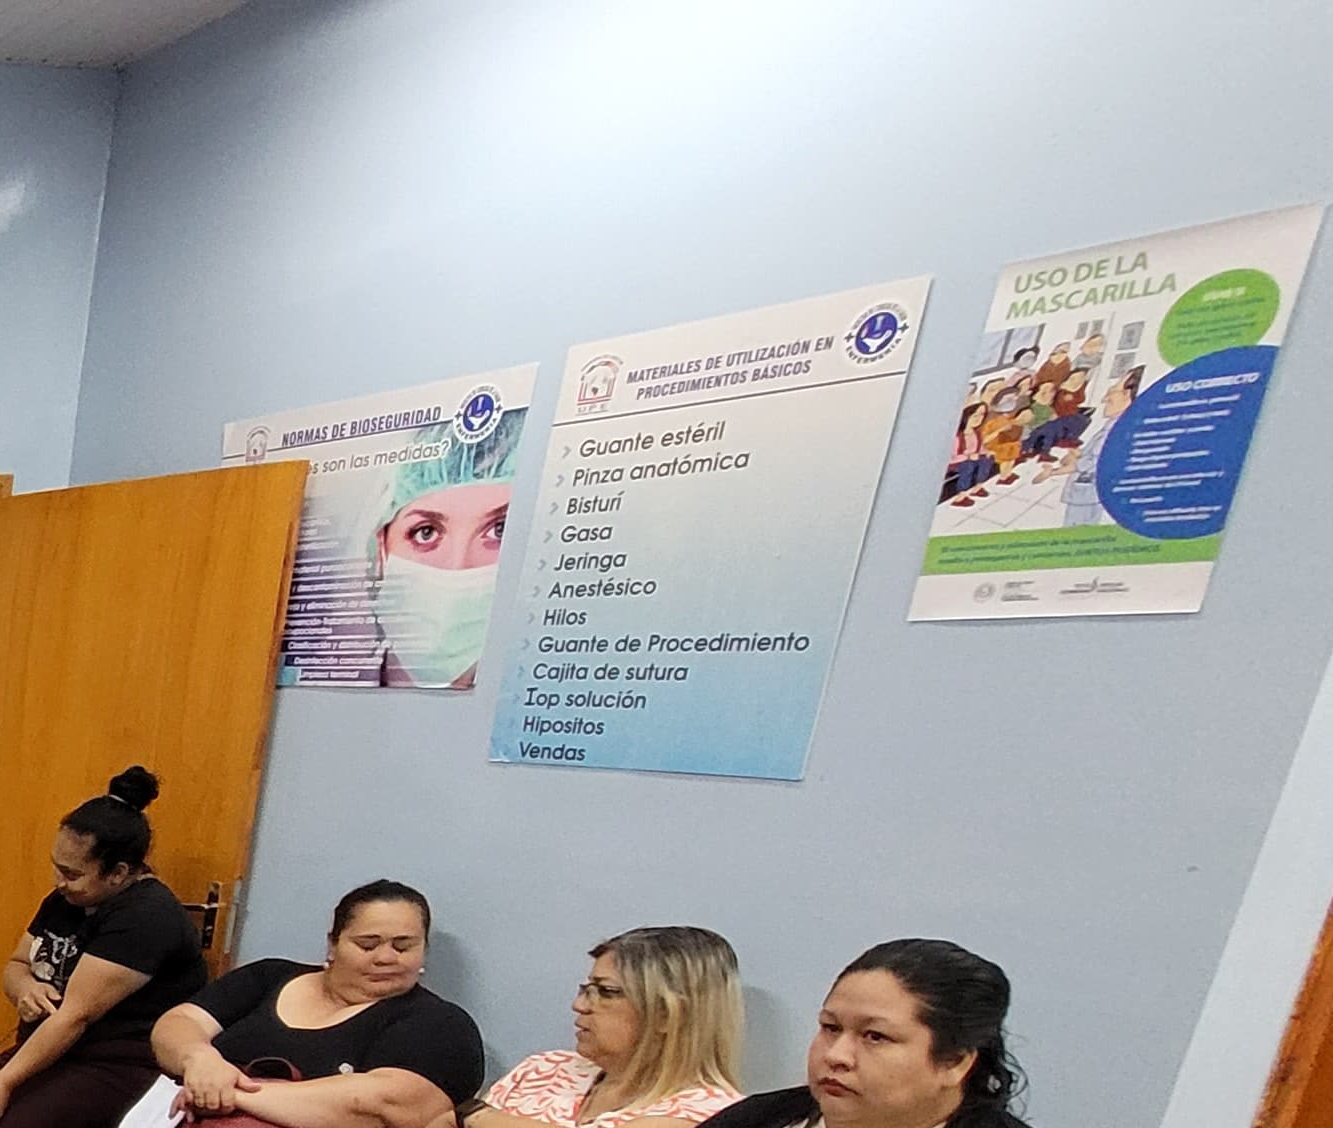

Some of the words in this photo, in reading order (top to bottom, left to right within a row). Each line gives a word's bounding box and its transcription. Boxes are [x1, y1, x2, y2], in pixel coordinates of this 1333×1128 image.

[1014, 267, 1067, 294] USO
[1073, 258, 1110, 284] DE
[1115, 252, 1149, 275] LA
[1005, 273, 1177, 320] MASCARILLA
[626, 359, 702, 385] MATERIALES
[705, 356, 722, 371] DE
[726, 337, 811, 367] UTILIZACIÓN
[815, 336, 834, 351] EN
[636, 372, 748, 400] PROCEDIMIENTOS
[751, 358, 811, 381] BÁSICOS
[282, 426, 328, 446] NORMAS
[331, 423, 346, 438] DE
[350, 406, 442, 435] BIOSEGURIDAD
[579, 433, 654, 458] Guante
[661, 421, 726, 447] estéril
[322, 457, 346, 473] son
[350, 454, 369, 470] las
[374, 440, 451, 467] medidas?
[572, 468, 624, 487] Pinza
[630, 452, 750, 480] anatómica
[566, 491, 625, 515] Bisturí
[560, 526, 613, 543] Gasa
[554, 553, 627, 573] Jeringa
[548, 578, 657, 599] Anestésico
[543, 609, 587, 626] Hilos
[538, 636, 609, 653] Guante
[615, 635, 641, 652] de
[647, 632, 810, 652] Procedimiento
[533, 663, 588, 683] Cajita
[594, 663, 620, 681] de
[625, 663, 688, 681] sutura
[524, 687, 560, 710] Iop
[565, 690, 647, 709] solución
[522, 716, 604, 735] Hipositos
[519, 742, 586, 761] Vendas
